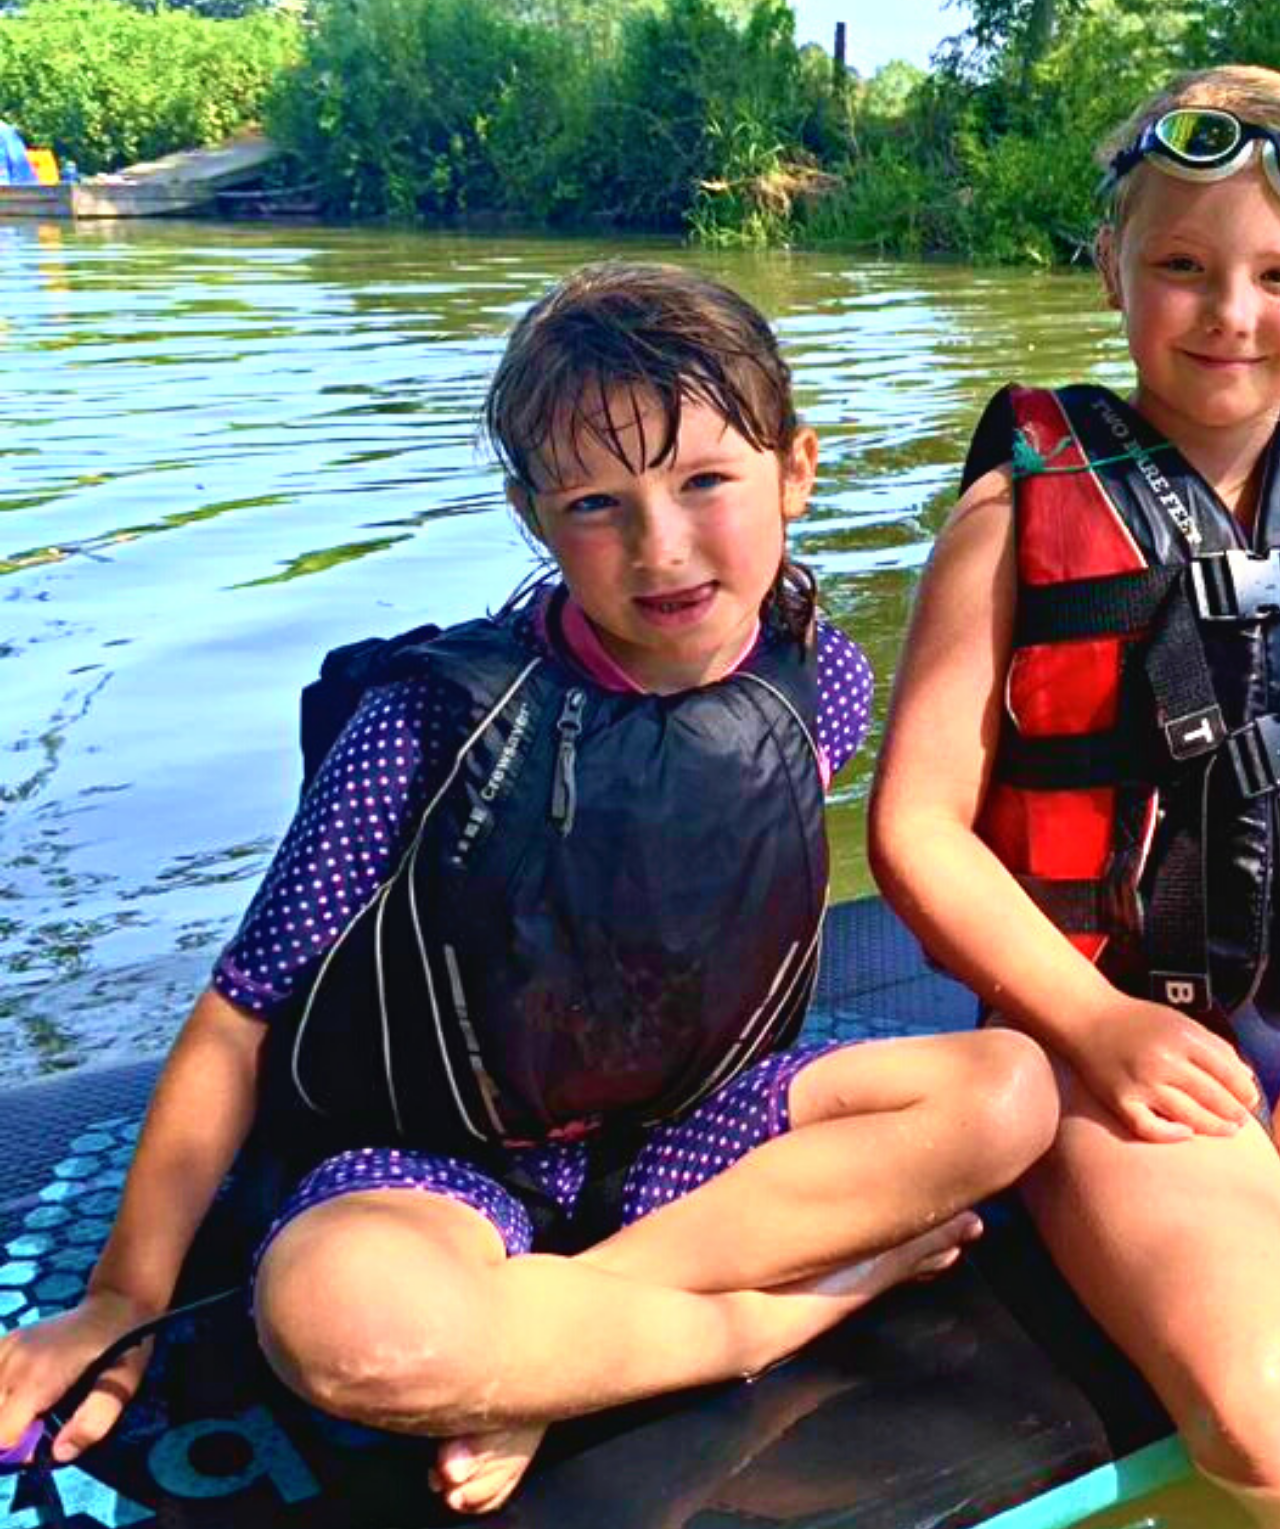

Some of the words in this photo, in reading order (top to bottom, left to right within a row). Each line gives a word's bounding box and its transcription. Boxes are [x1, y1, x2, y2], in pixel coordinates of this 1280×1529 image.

[1091, 398, 1130, 438] TWO
[1160, 492, 1203, 545] FEET
[1183, 717, 1214, 743] T
[1164, 980, 1196, 1004] B
